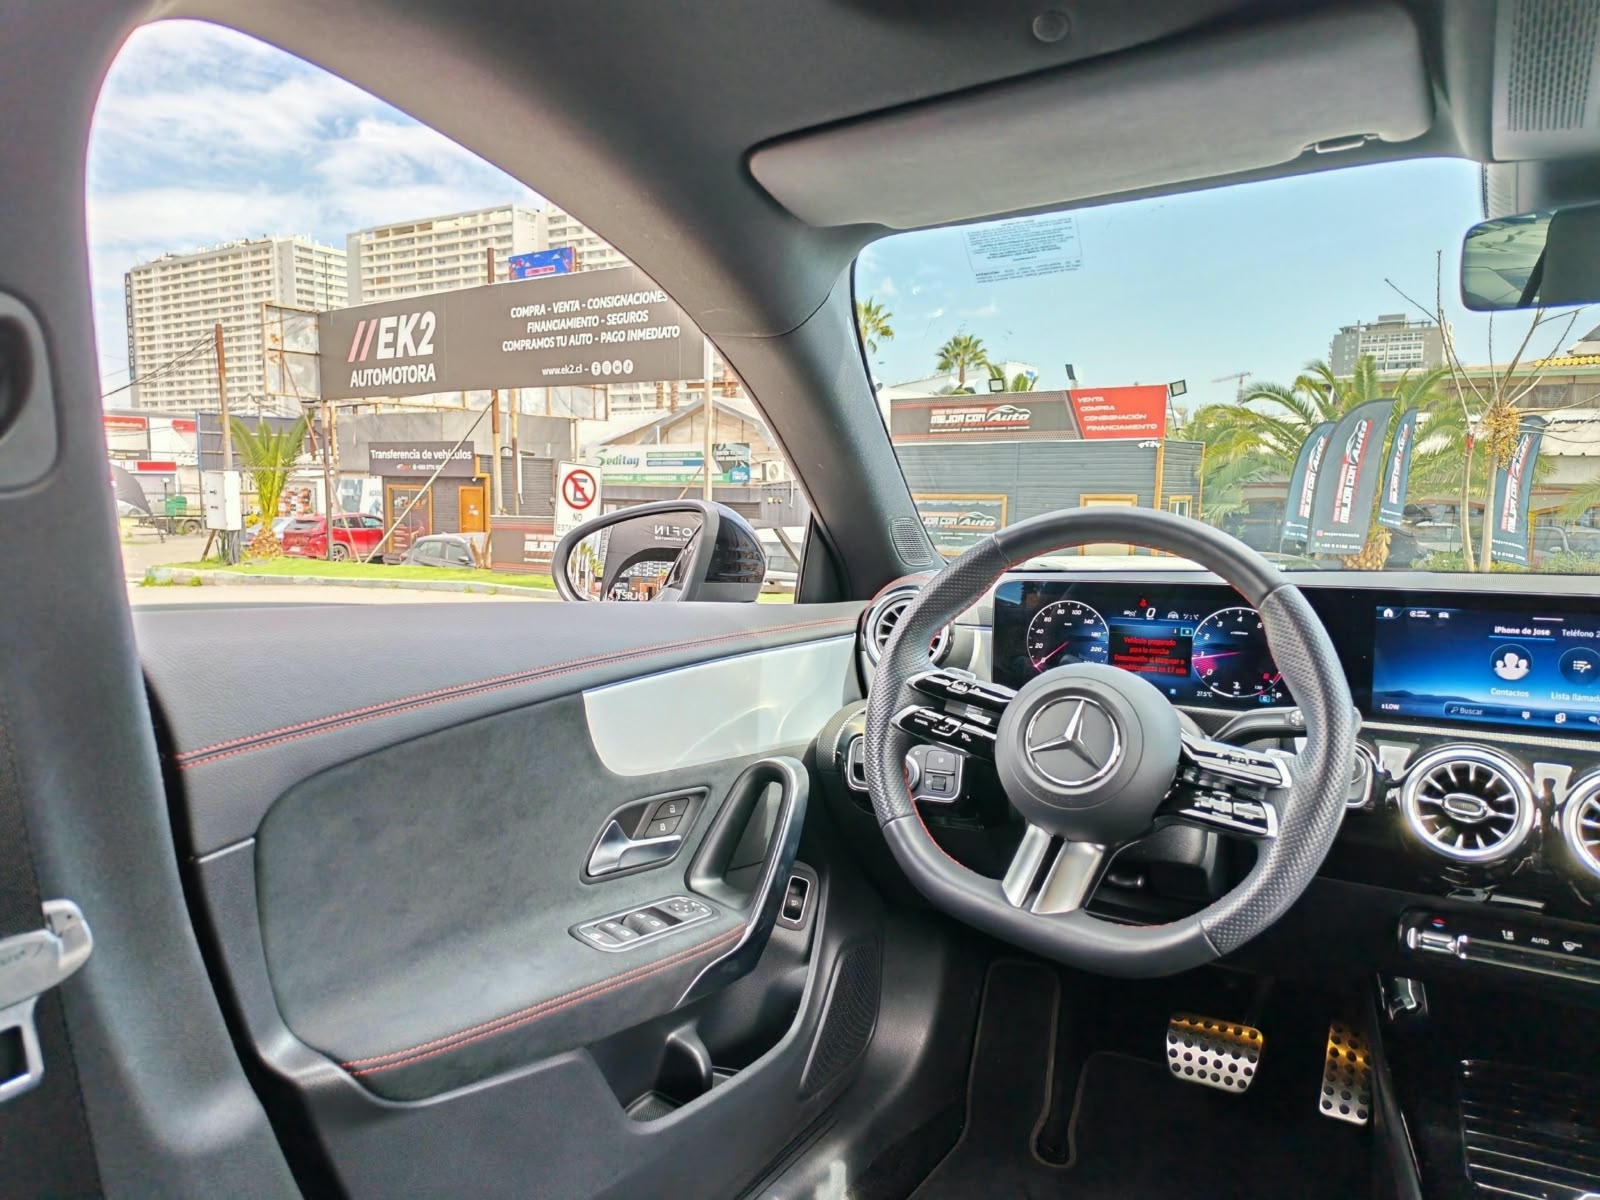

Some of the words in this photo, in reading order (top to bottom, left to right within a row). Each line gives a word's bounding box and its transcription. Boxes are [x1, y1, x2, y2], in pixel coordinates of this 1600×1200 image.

[510, 303, 546, 318] COMPRA
[552, 299, 581, 314] VENTA
[527, 315, 599, 333] FINANCIAMIENTO
[606, 309, 649, 325] SEGUROS
[502, 336, 555, 352] COMPRAMOS
[556, 335, 567, 348] TU
[568, 333, 593, 346] AUTO
[600, 330, 626, 344] PAGO
[627, 325, 681, 342] INMEDIATO
[349, 363, 436, 388] AUTOMOTORA
[541, 364, 583, 376] www.ek2.cl
[965, 413, 986, 423] CON
[1086, 423, 1158, 432] FINANCIAMIENTO
[370, 448, 420, 460] Transferencia
[421, 449, 432, 460] de
[572, 513, 583, 522] NO
[1494, 625, 1520, 634] iPhone
[1521, 627, 1531, 635] de
[1533, 628, 1551, 636] Jose
[1562, 628, 1594, 638] Teléfono
[1490, 687, 1529, 698] Contactos
[1550, 691, 1570, 701] Lista
[1459, 707, 1483, 716] Buscar
[1531, 936, 1550, 945] AUTO
